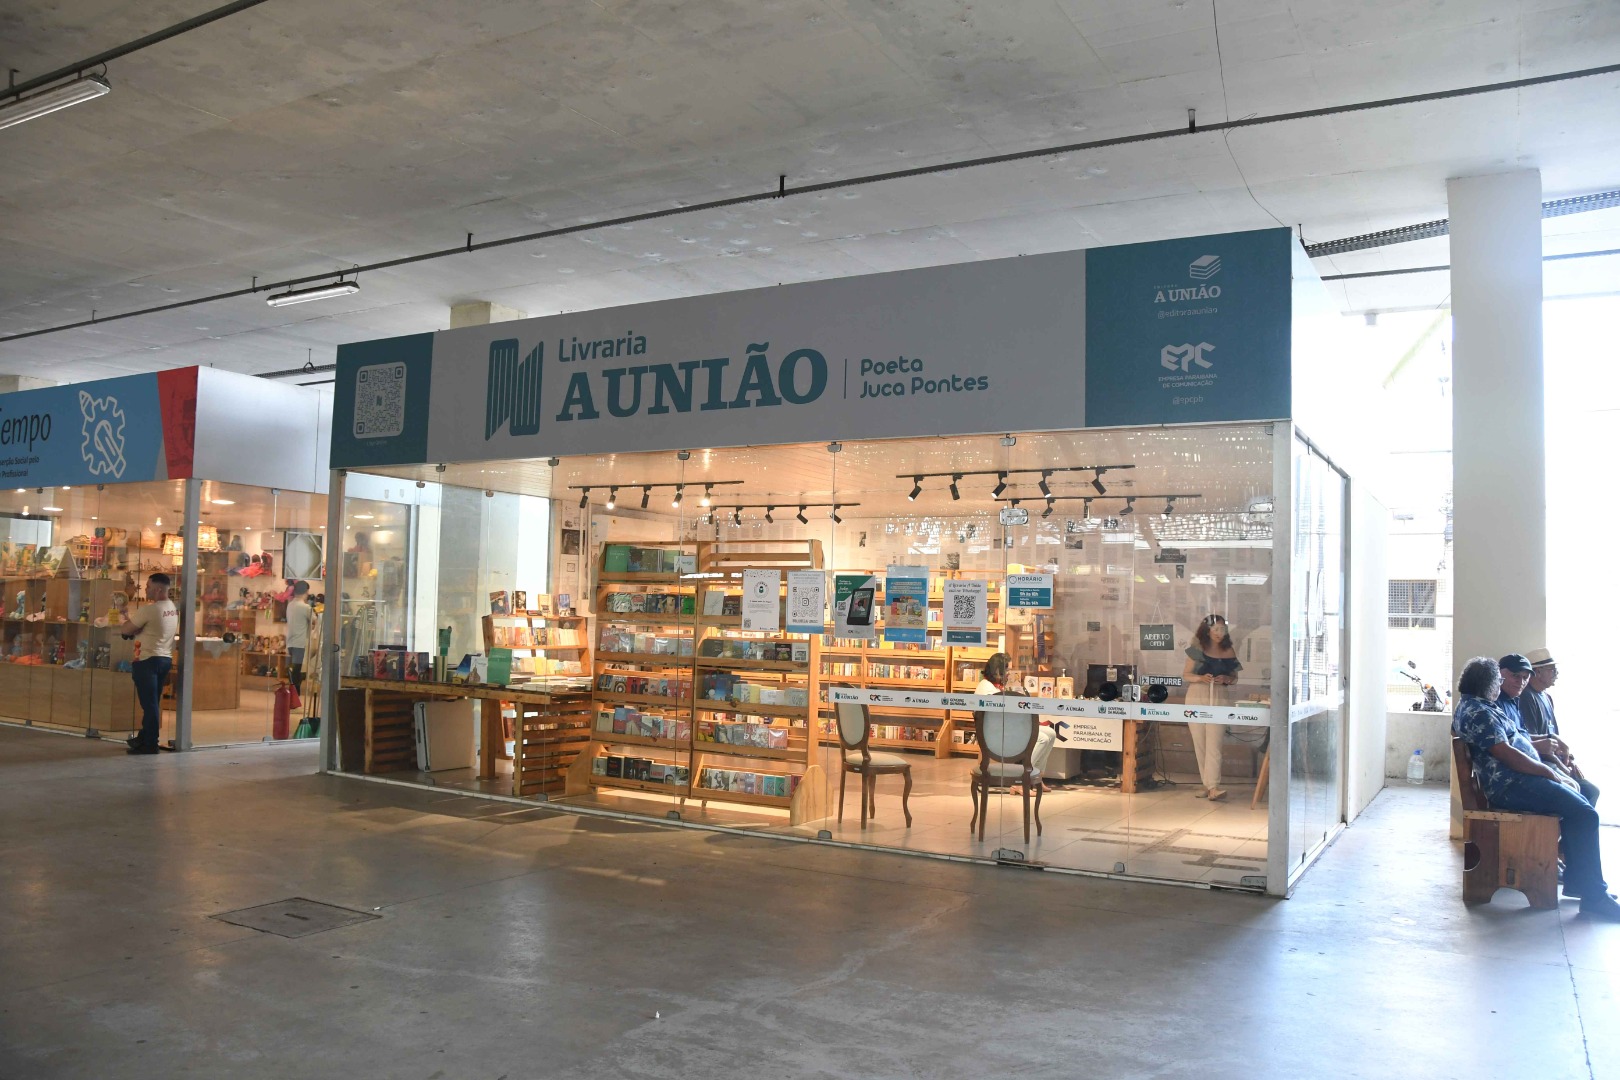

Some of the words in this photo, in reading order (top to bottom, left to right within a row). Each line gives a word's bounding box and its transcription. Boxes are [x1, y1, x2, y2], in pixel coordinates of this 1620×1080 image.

[1153, 290, 1167, 304] A
[1168, 283, 1222, 302] UNIÃO
[558, 330, 647, 363] Livraria
[1160, 341, 1216, 373] EPC
[860, 355, 924, 377] Poeta
[860, 380, 905, 399] Juca
[911, 373, 990, 395] Pontes
[0, 407, 52, 453] empo
[1143, 633, 1170, 641] ABERTO
[1149, 677, 1182, 686] EMPURRE
[1073, 736, 1112, 744] COMUNICAÇÃO
